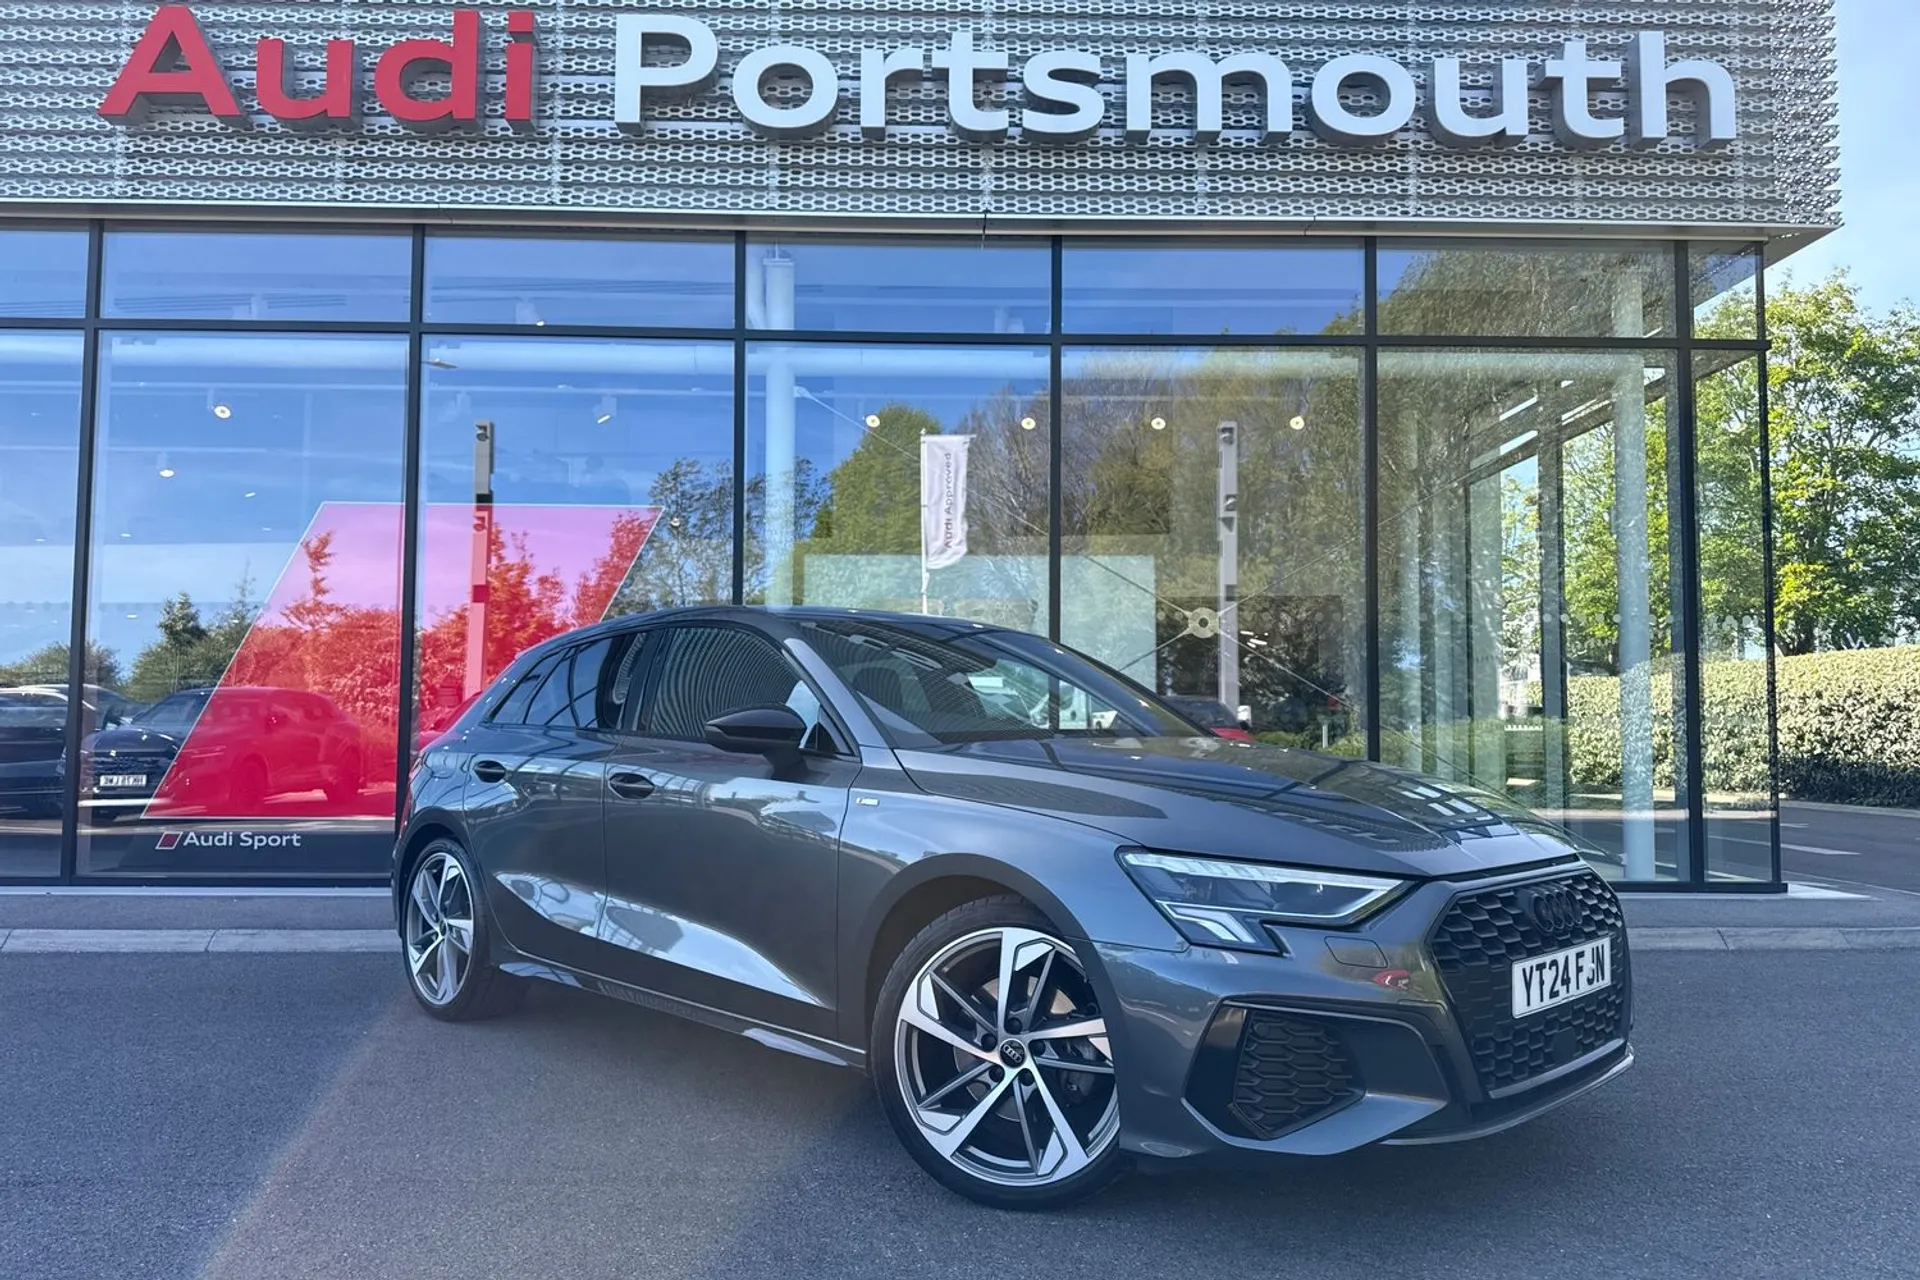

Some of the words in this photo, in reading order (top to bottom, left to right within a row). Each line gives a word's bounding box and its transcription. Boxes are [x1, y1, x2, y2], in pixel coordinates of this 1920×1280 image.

[98, 4, 536, 121] Audi
[614, 13, 1738, 140] Portsmouth
[943, 452, 954, 516] Approved
[943, 518, 953, 549] Audi
[183, 831, 233, 846] Audi
[239, 831, 301, 850] Sport
[1522, 954, 1571, 1007] YT24
[1575, 943, 1605, 990] FJN
